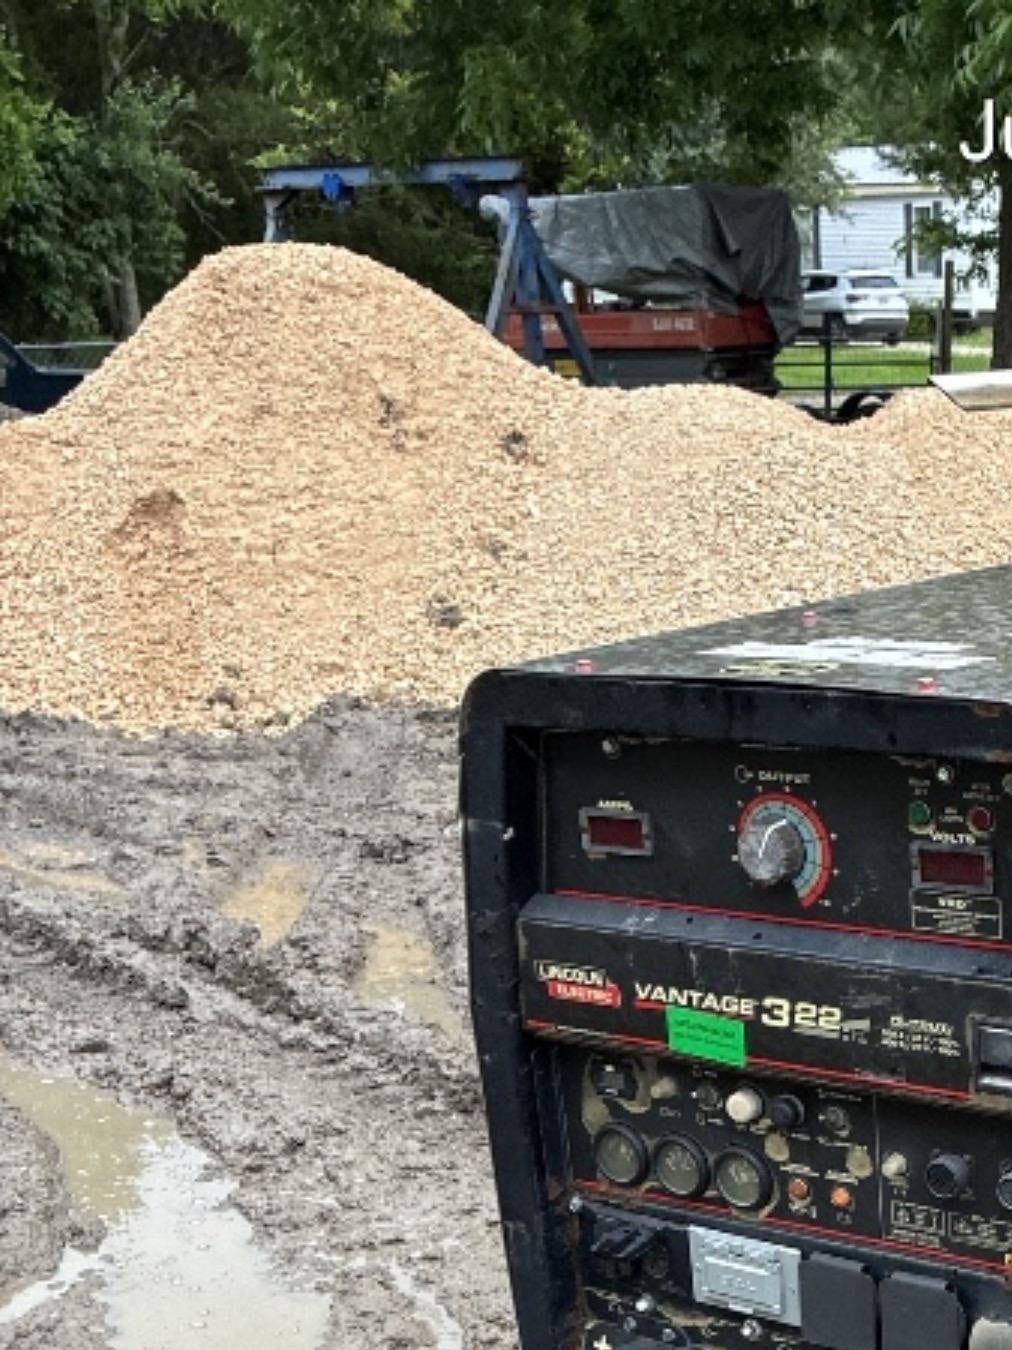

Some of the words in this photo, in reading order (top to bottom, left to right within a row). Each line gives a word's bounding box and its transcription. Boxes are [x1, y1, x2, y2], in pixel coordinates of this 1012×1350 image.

[758, 770, 811, 784] OUTPUT
[538, 962, 605, 986] LINCOLN
[635, 981, 754, 1016] VANTAGE
[761, 995, 842, 1031] 322
